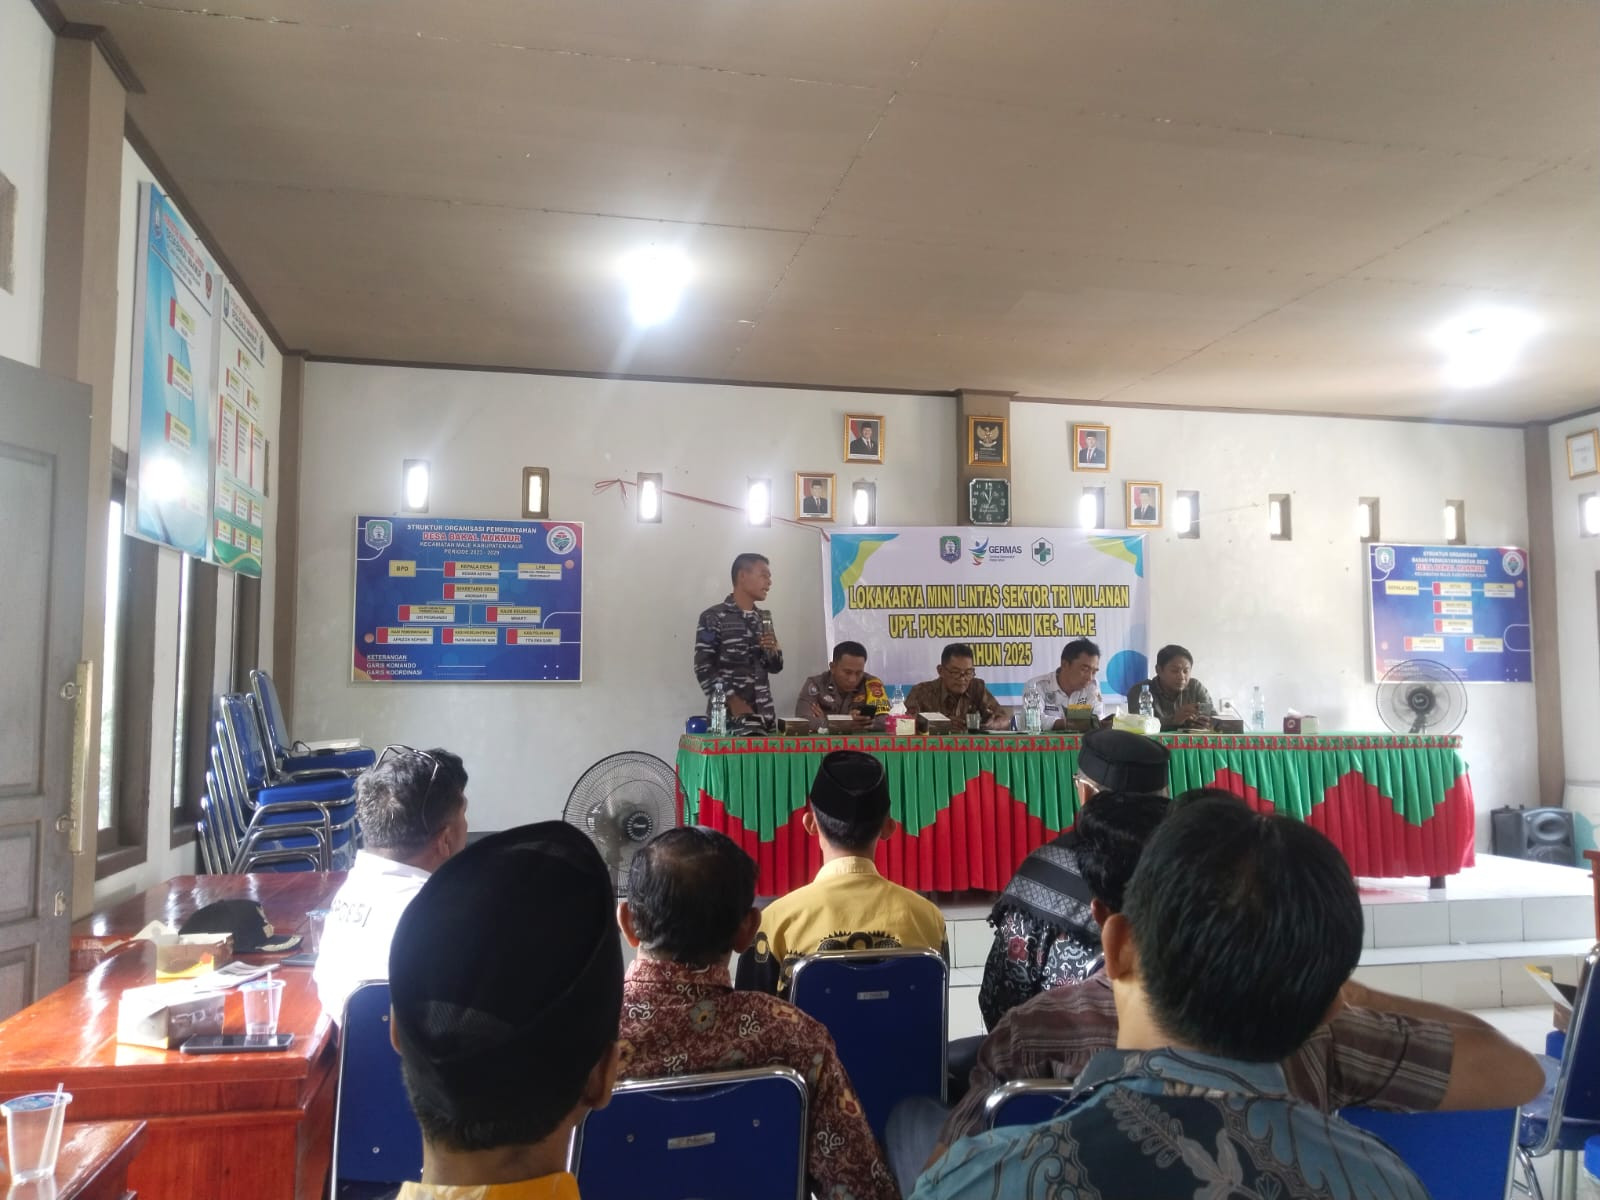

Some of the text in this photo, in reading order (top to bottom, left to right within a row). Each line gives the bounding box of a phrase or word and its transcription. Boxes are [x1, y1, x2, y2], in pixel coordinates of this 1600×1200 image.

[423, 532, 521, 543] DESA BAKAL MAKMUR
[487, 526, 536, 534] PEMERINTAHAN
[988, 545, 1022, 554] GERMAS
[848, 584, 1129, 609] LOKAKARYA MINI LINTAS SEKTOR TRI WULANAN
[889, 613, 1096, 638] UPT. PUSKESMAS LINAU KEC. MAJE
[1004, 642, 1032, 666] 2025
